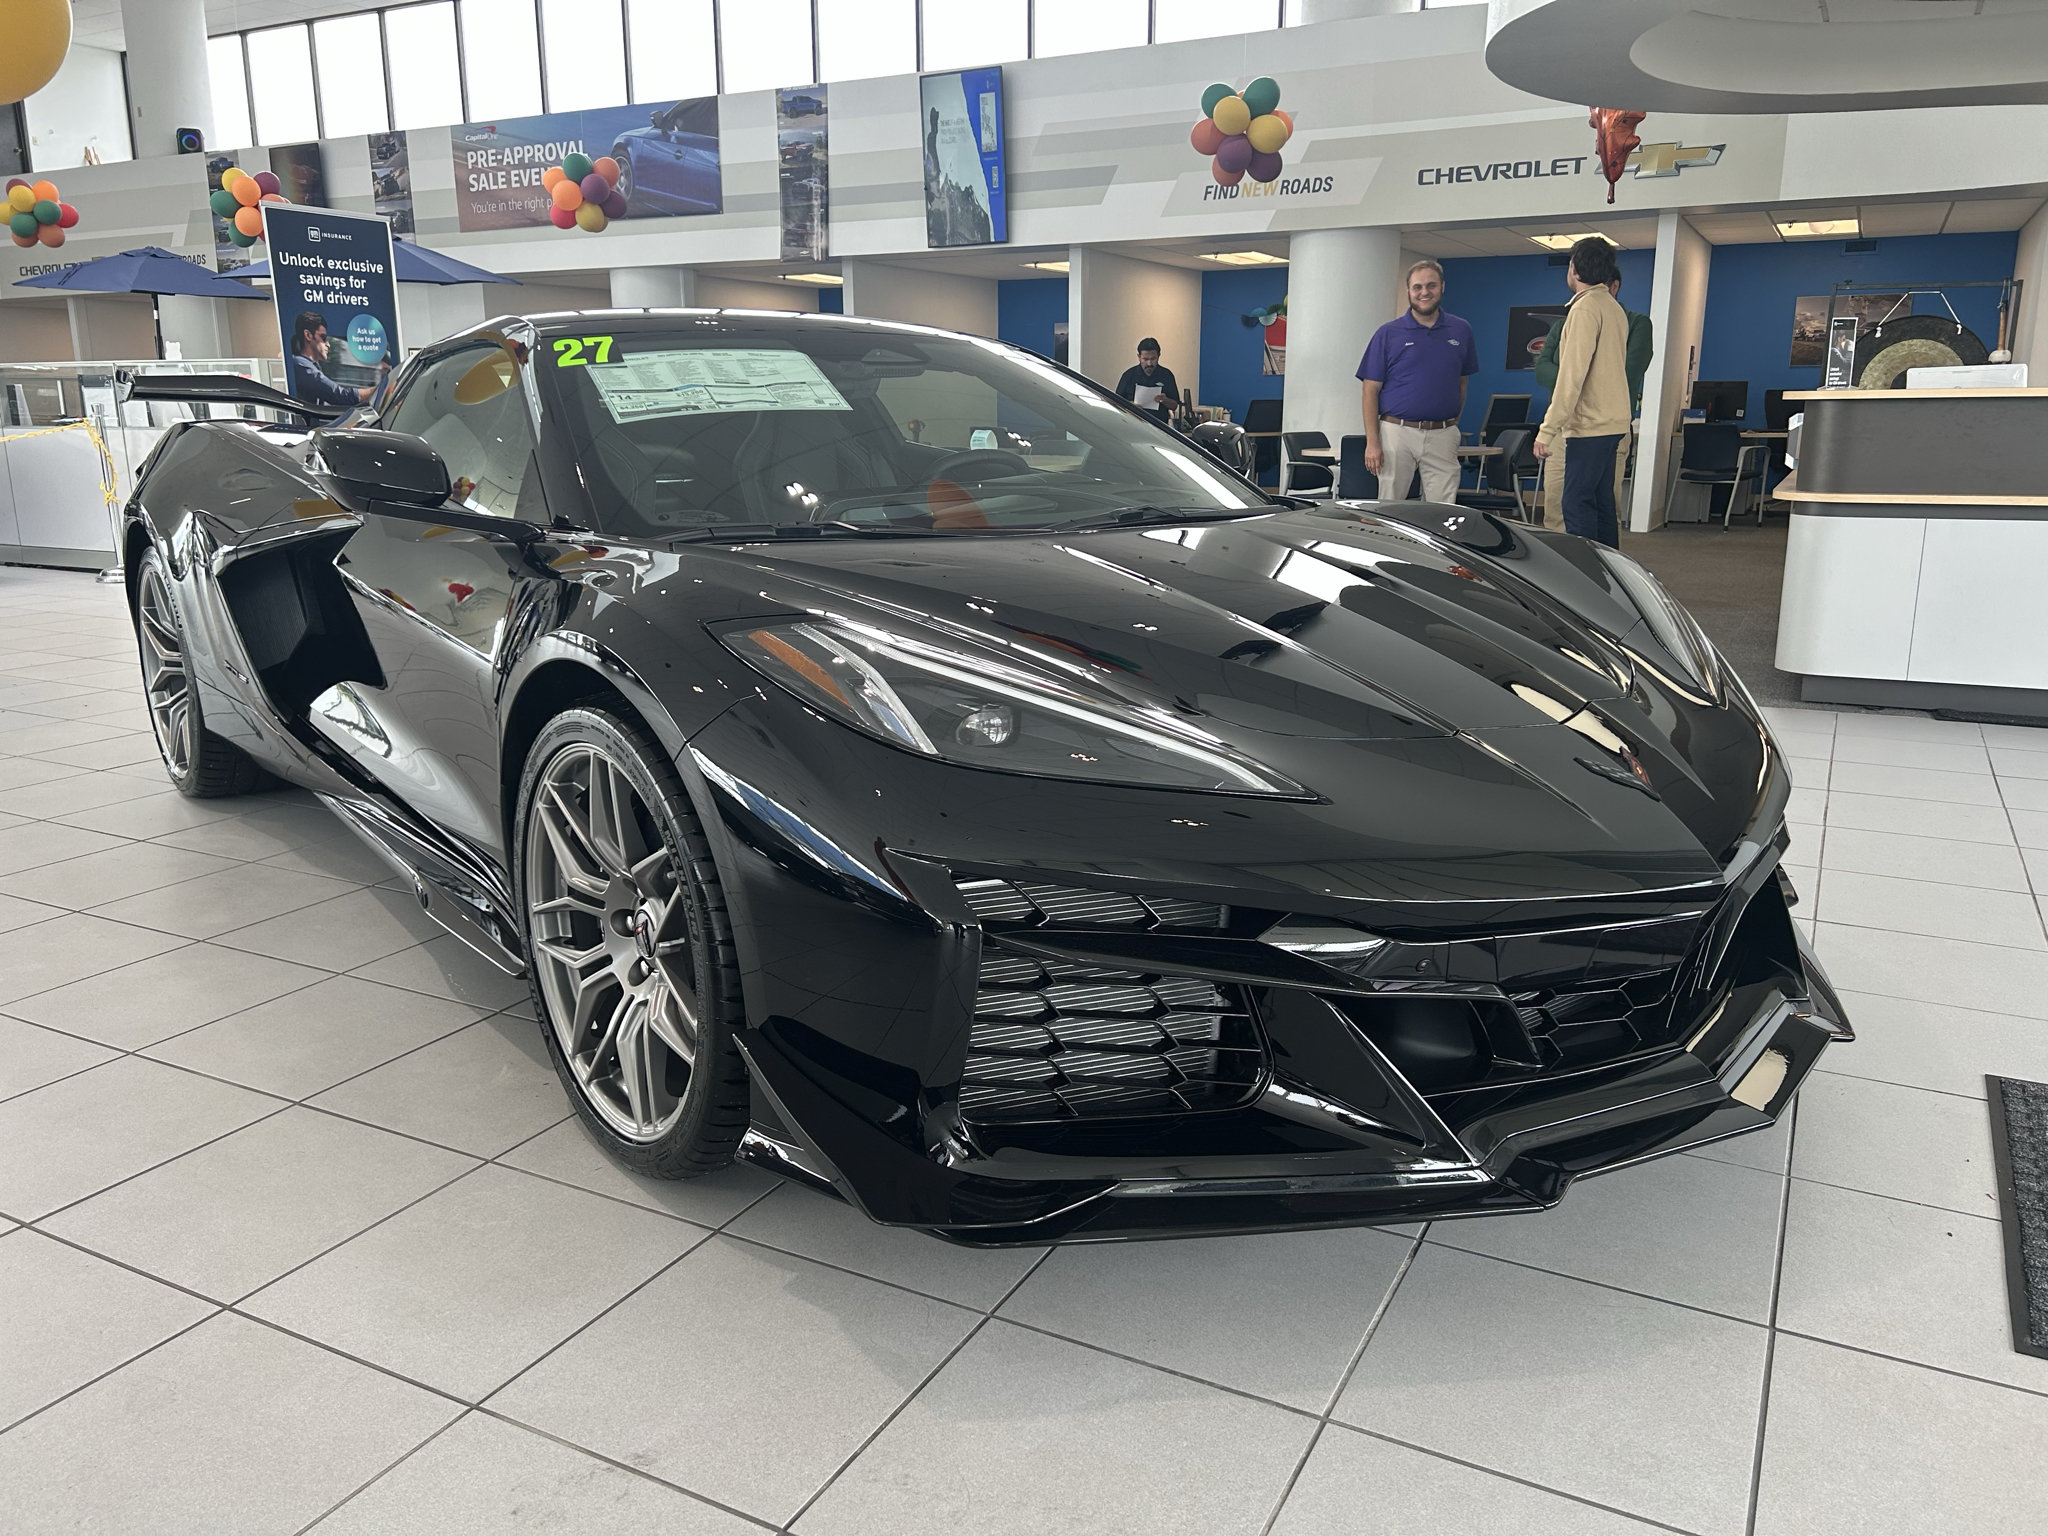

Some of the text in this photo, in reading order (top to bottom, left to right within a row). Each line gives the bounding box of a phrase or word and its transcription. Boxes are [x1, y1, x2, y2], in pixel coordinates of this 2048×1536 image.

[466, 140, 588, 169] PRE-APPROVAL
[468, 166, 555, 192] SALE EVE
[1417, 156, 1588, 186] CHEVROLET
[1203, 176, 1334, 200] FIND NEW ROADS
[471, 201, 497, 214] You're
[498, 200, 507, 211] in
[508, 198, 523, 210] the
[525, 196, 545, 212] right
[321, 232, 353, 241] INSURANCE
[279, 251, 384, 274] Unlock exclusive
[299, 273, 367, 289] savings for
[303, 289, 370, 306] GM drivers
[352, 335, 365, 343] how
[357, 327, 368, 335] Ask
[362, 344, 379, 352] quote
[552, 335, 614, 368] 27
